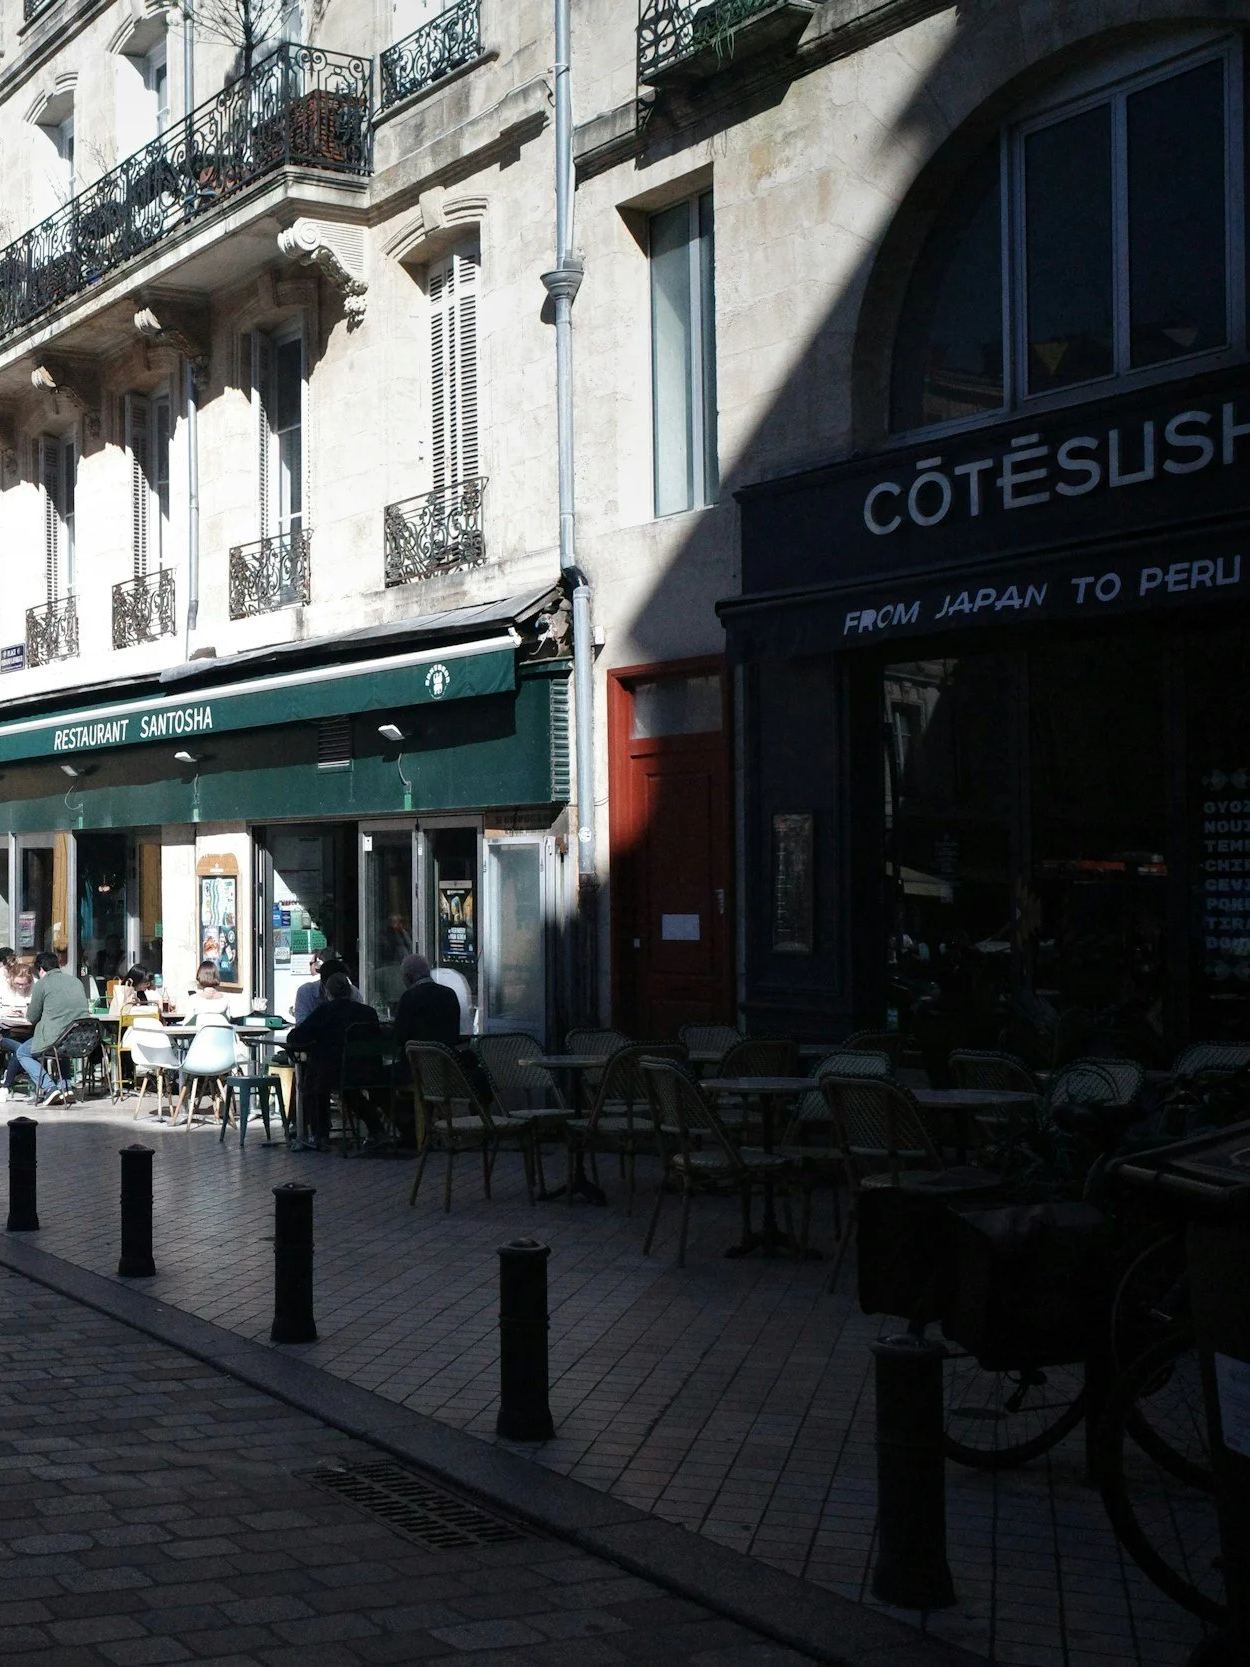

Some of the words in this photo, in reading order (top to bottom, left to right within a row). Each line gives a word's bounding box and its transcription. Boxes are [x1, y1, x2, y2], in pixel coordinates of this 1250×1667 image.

[843, 601, 921, 635] FROM
[934, 582, 1049, 620] JAPAN
[1070, 572, 1122, 604] TO
[1138, 555, 1242, 597] PERU
[54, 720, 129, 750] RESTAURANT
[140, 706, 213, 738] SANTOSHA
